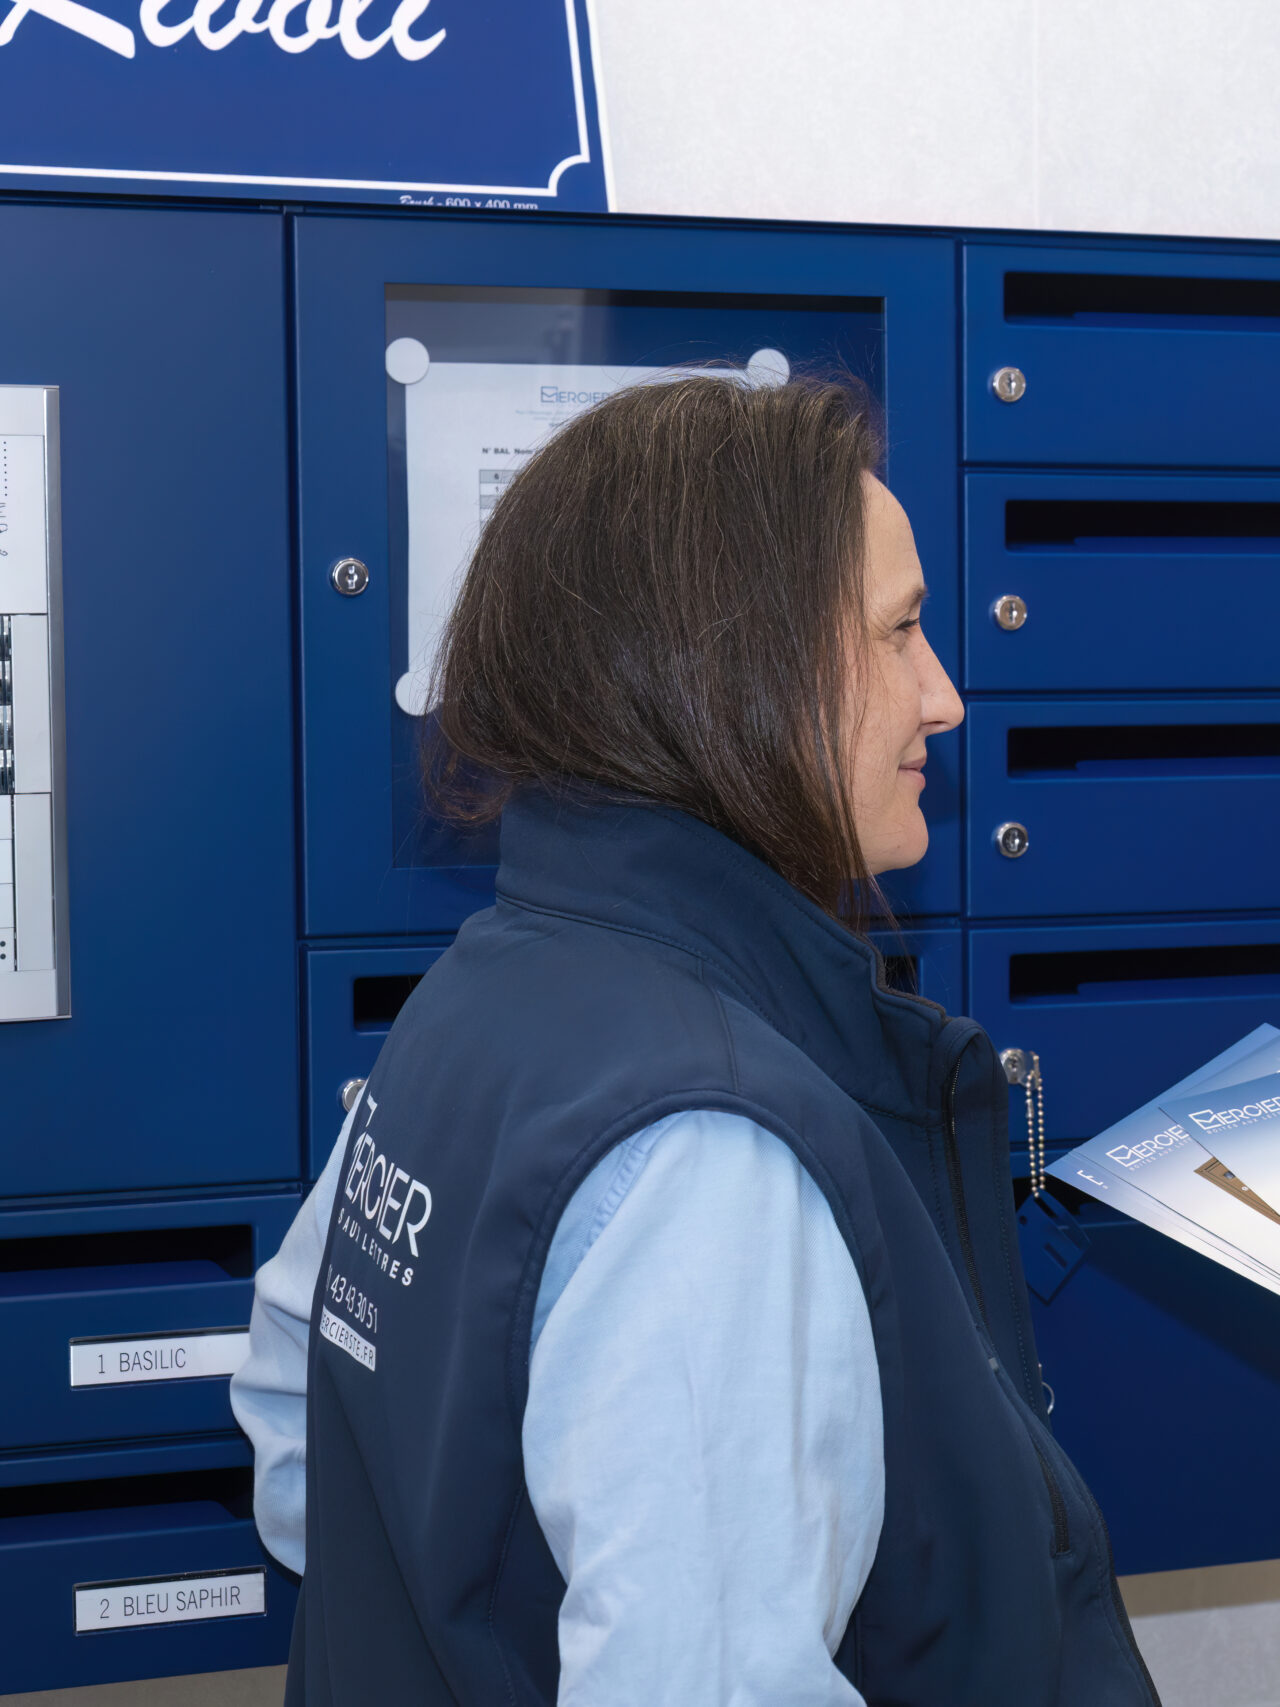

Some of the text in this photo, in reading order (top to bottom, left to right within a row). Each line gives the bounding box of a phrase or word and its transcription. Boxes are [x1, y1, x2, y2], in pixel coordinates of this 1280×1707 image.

[445, 197, 471, 207] 600
[485, 199, 510, 209] 400
[1106, 1124, 1190, 1168] MERCIE
[345, 1131, 432, 1258] ERCIER
[330, 1273, 346, 1303] 43
[345, 1283, 356, 1313] 43
[354, 1292, 367, 1323] 30
[365, 1302, 378, 1333] 51
[97, 1348, 187, 1374] 1 BASILIC
[100, 1586, 241, 1619] 2 BLEU SAPHIR
